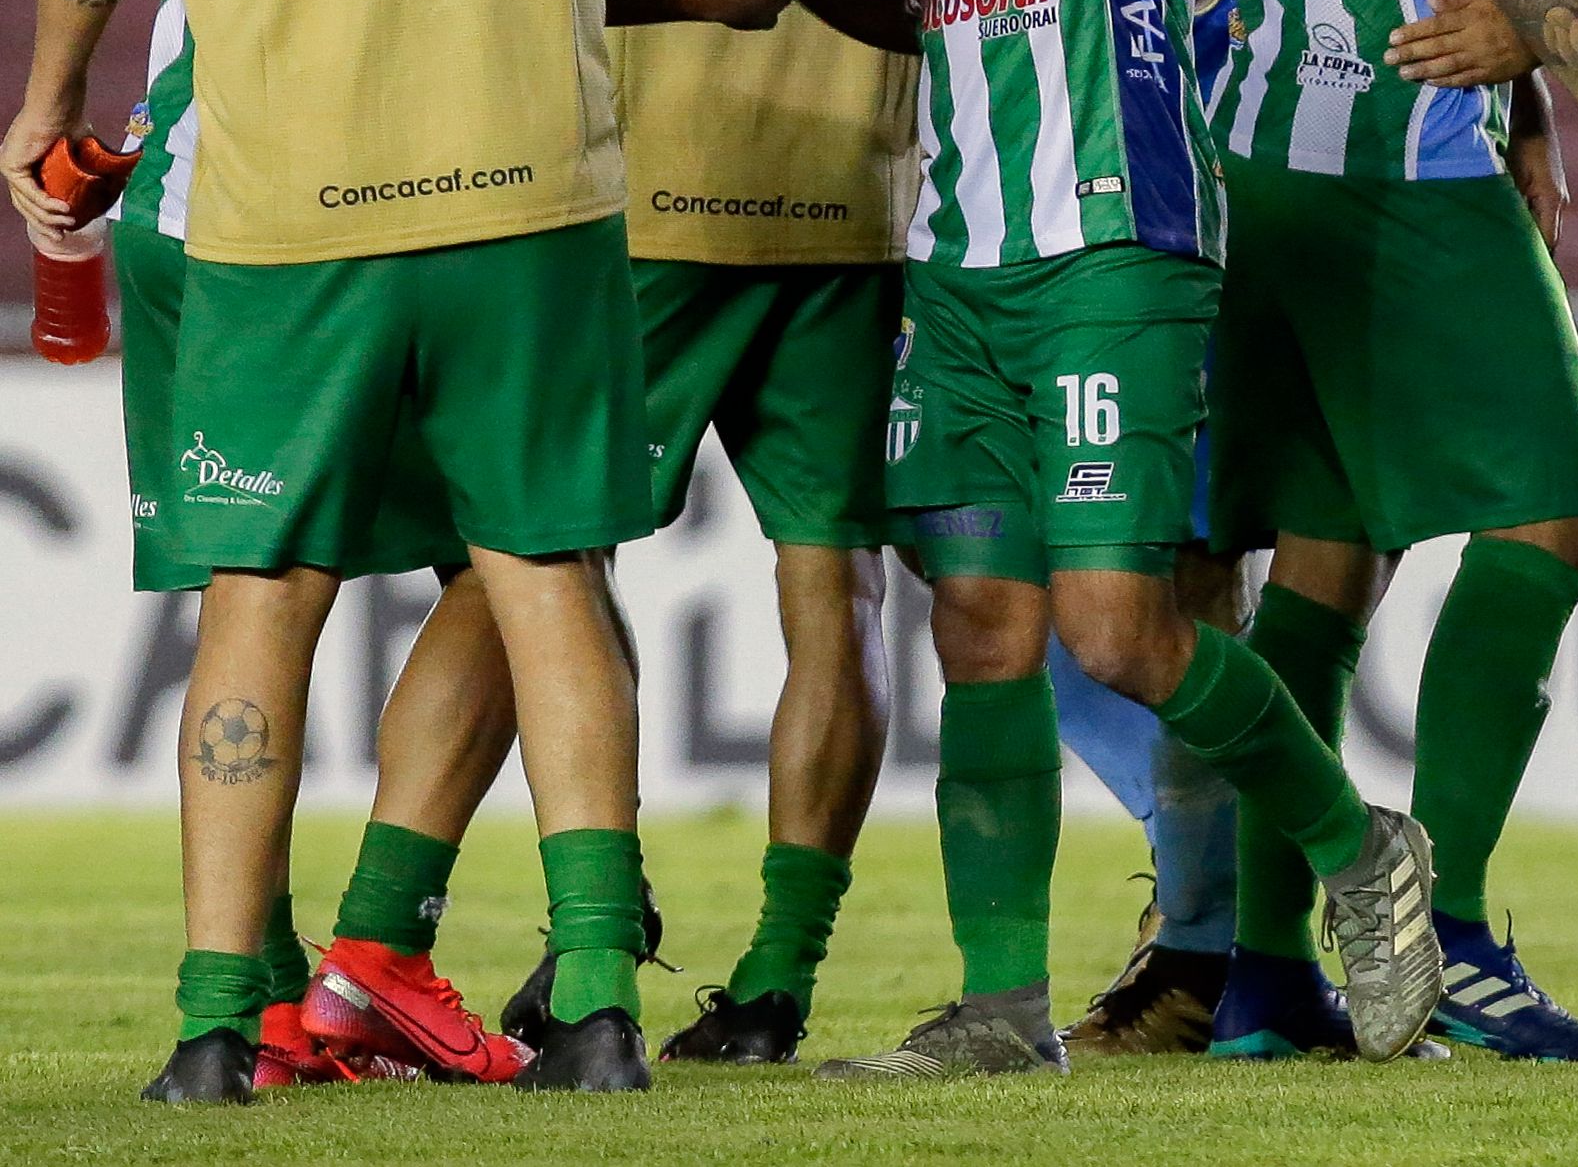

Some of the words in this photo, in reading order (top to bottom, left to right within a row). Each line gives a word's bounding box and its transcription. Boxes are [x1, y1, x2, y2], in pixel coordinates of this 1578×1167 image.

[979, 17, 1019, 40] SUERO
[319, 164, 535, 210] Concacaf.com
[651, 189, 849, 221] Concacaf.com
[1056, 372, 1121, 447] 16
[198, 459, 285, 496] Detalles
